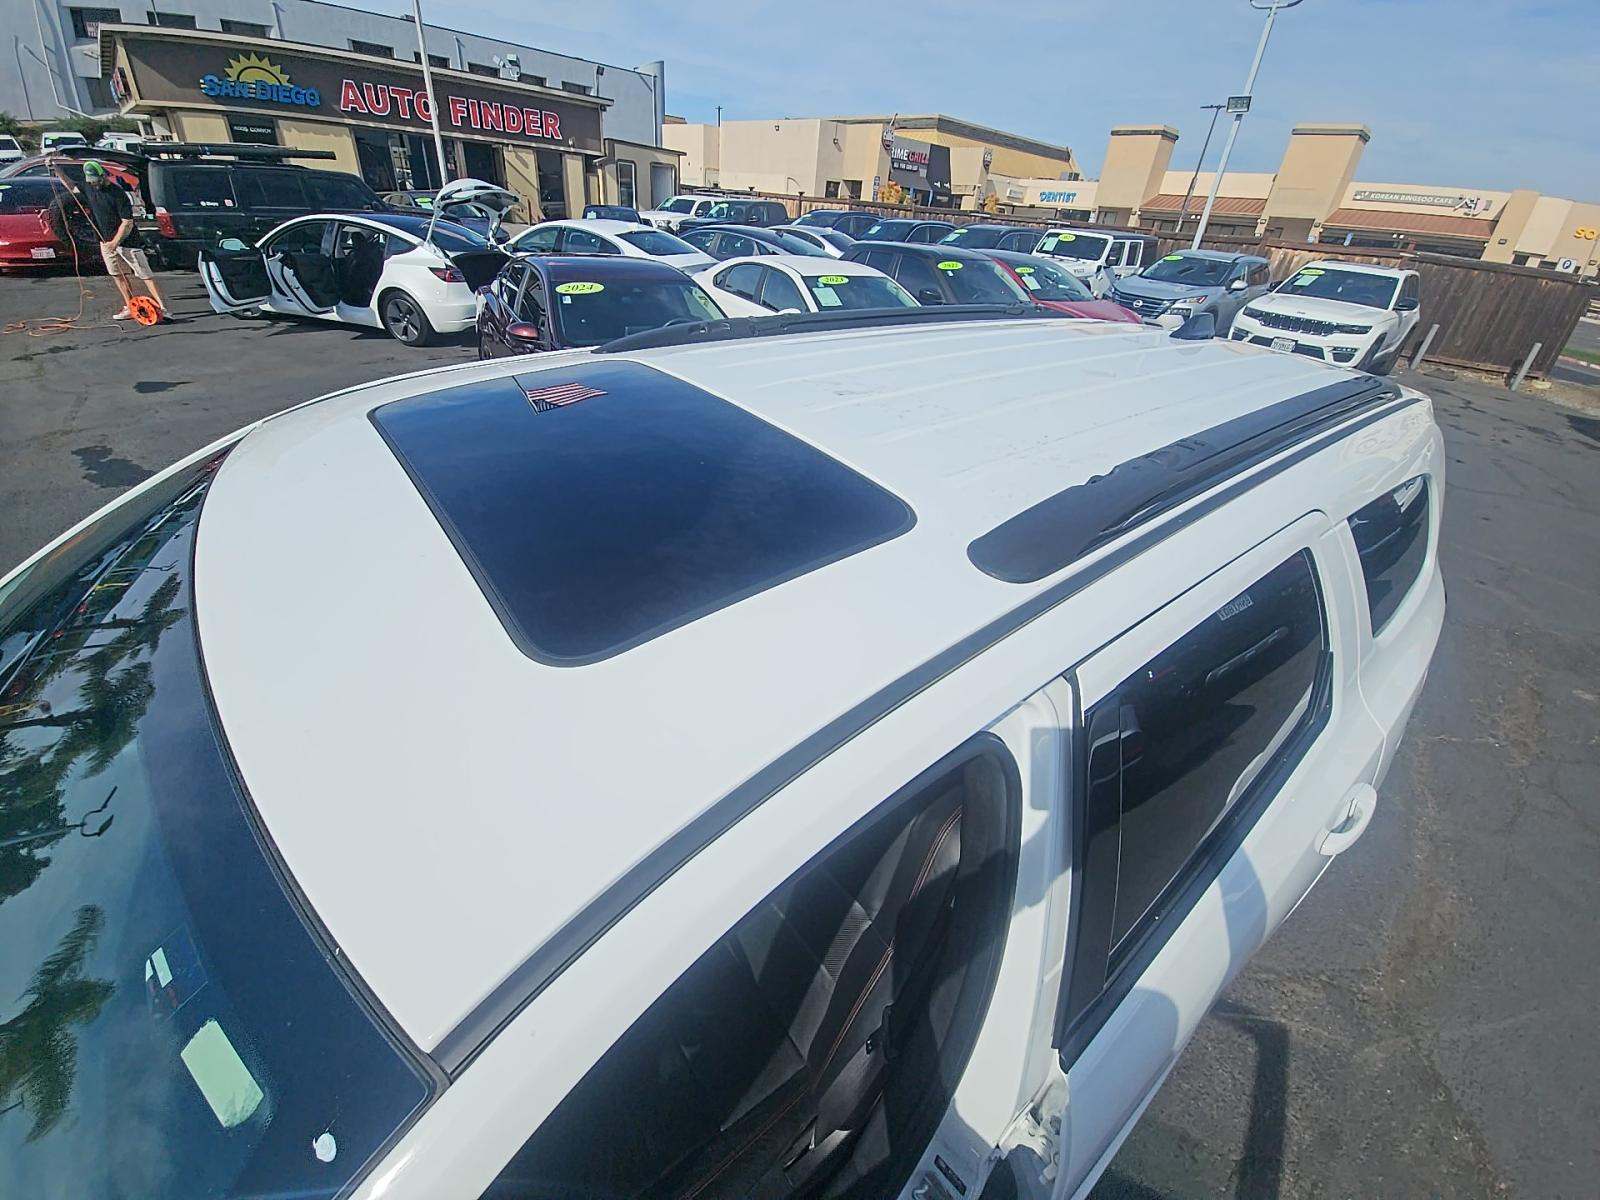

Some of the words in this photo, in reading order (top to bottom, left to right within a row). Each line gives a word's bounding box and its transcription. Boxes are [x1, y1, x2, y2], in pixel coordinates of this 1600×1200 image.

[203, 74, 250, 98] SAN
[255, 79, 321, 107] DIEGO
[341, 79, 439, 122] AUTO
[449, 95, 563, 140] FINDER
[890, 146, 909, 161] RIME
[1040, 191, 1077, 204] DENTIST
[1370, 192, 1400, 201] KOREAN
[1400, 194, 1433, 203] BINGSOO
